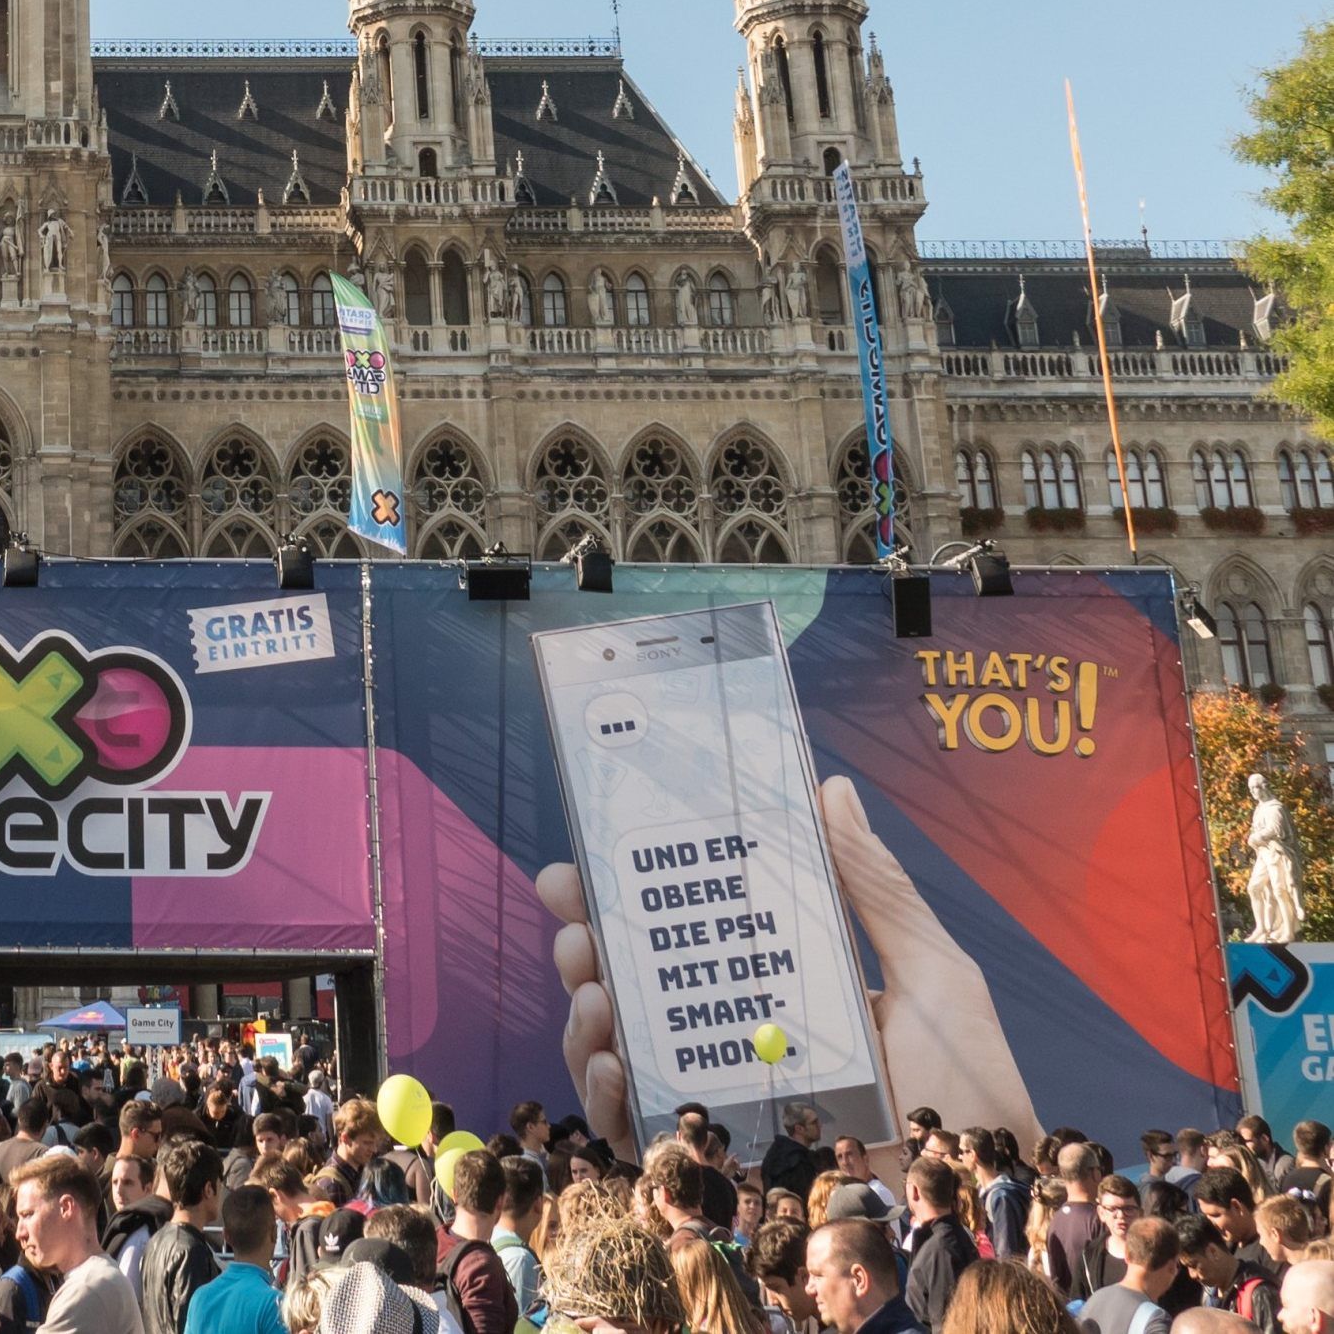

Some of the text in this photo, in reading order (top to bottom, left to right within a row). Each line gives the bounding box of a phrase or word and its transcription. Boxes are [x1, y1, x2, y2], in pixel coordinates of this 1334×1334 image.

[205, 605, 314, 642] GRATIS
[208, 633, 316, 661] EINTRITT
[636, 647, 682, 662] SONY
[915, 650, 1071, 693] THAT'S
[920, 662, 1098, 757] YOU!
[632, 835, 758, 873] UND ER-
[641, 875, 746, 912] OBERE
[649, 911, 777, 952] DIE PS4
[658, 949, 795, 992] MIT DEM
[131, 1018, 175, 1029] Game City
[667, 993, 786, 1032] SMART-
[675, 1035, 797, 1073] PHON.
